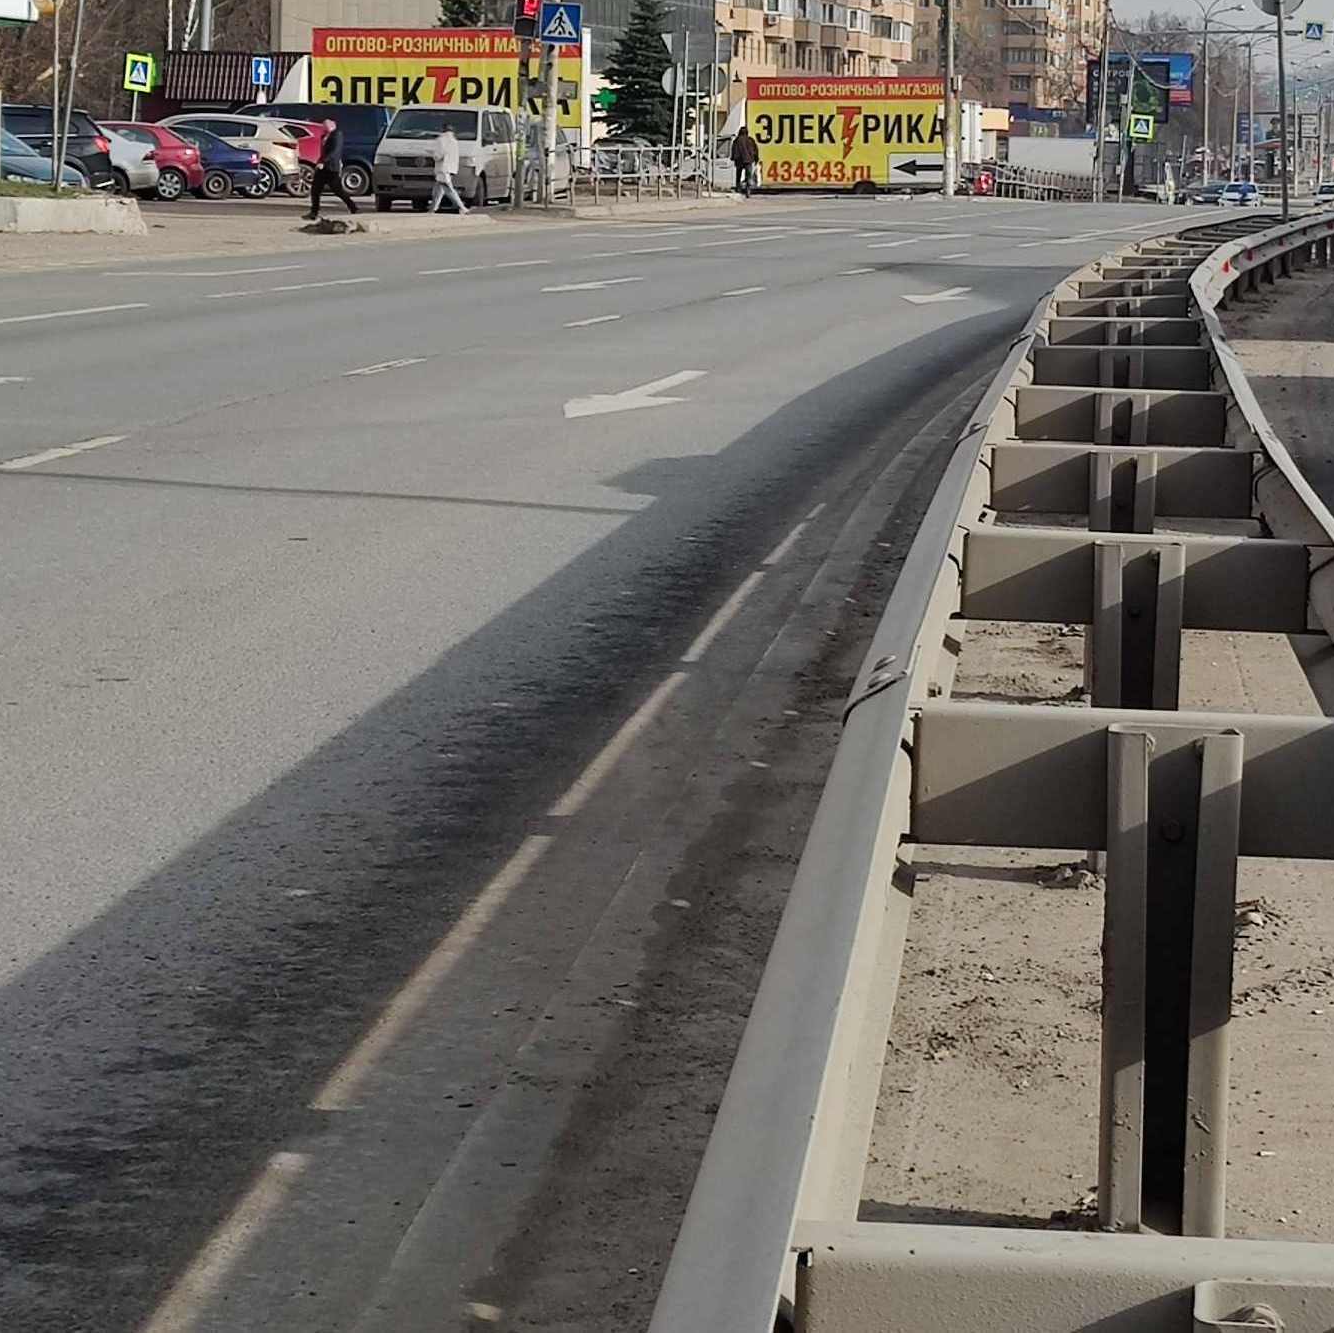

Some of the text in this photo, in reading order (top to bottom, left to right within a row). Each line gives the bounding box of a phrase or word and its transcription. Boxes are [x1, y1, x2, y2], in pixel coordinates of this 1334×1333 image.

[325, 33, 491, 53] ОПТОВО-РОЗНИЧНЫЙ
[758, 81, 886, 97] ОПТОВО-РОЗНИЧНЫЙ
[755, 106, 945, 159] ЭЛЕКТРИКА
